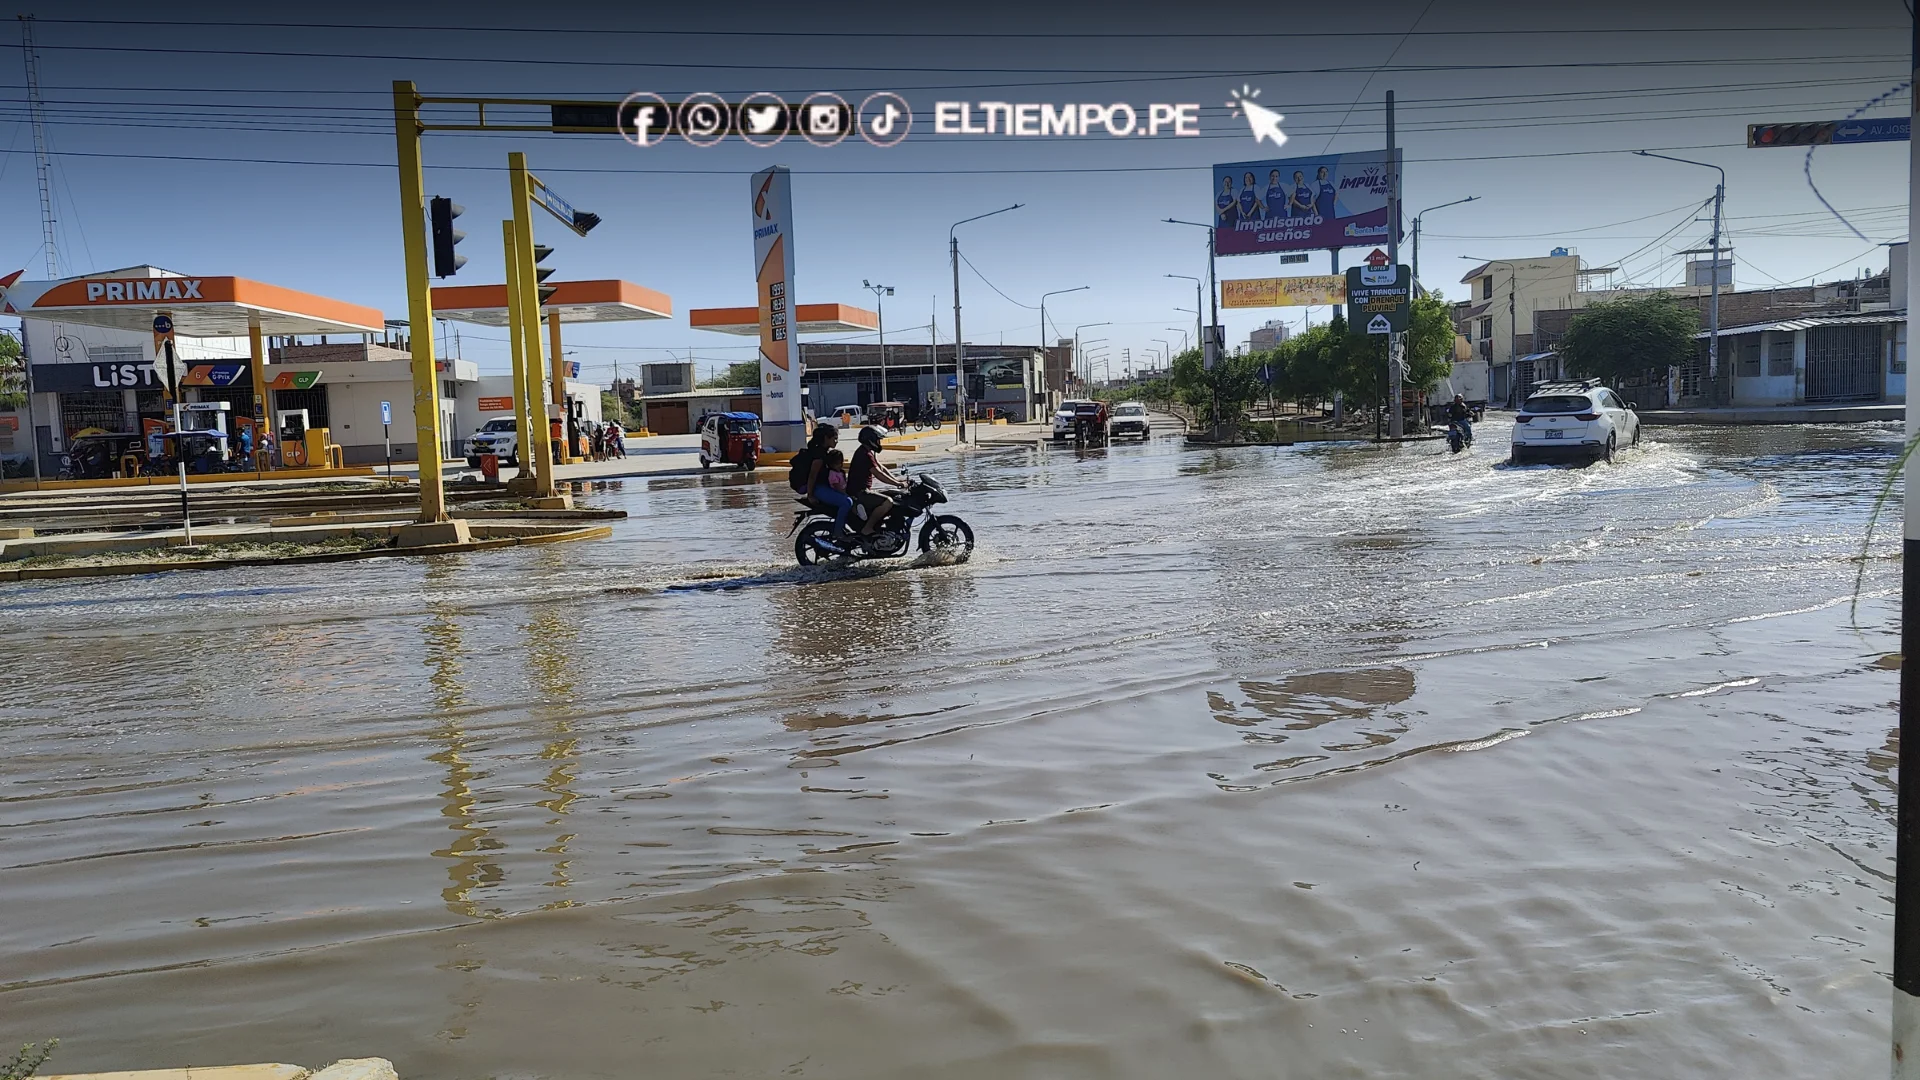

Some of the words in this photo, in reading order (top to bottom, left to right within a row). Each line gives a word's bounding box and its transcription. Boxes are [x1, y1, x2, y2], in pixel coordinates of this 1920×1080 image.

[1870, 125, 1885, 134] AV.
[1886, 124, 1911, 134] JOSE
[1234, 213, 1324, 232] Impulsando
[754, 224, 778, 240] PRIMAX
[1257, 228, 1311, 243] sueños
[86, 279, 204, 303] PRIMAX
[1370, 288, 1407, 296] TRANQUILO
[1369, 296, 1404, 304] DRENAJE
[92, 363, 188, 389] LiST
